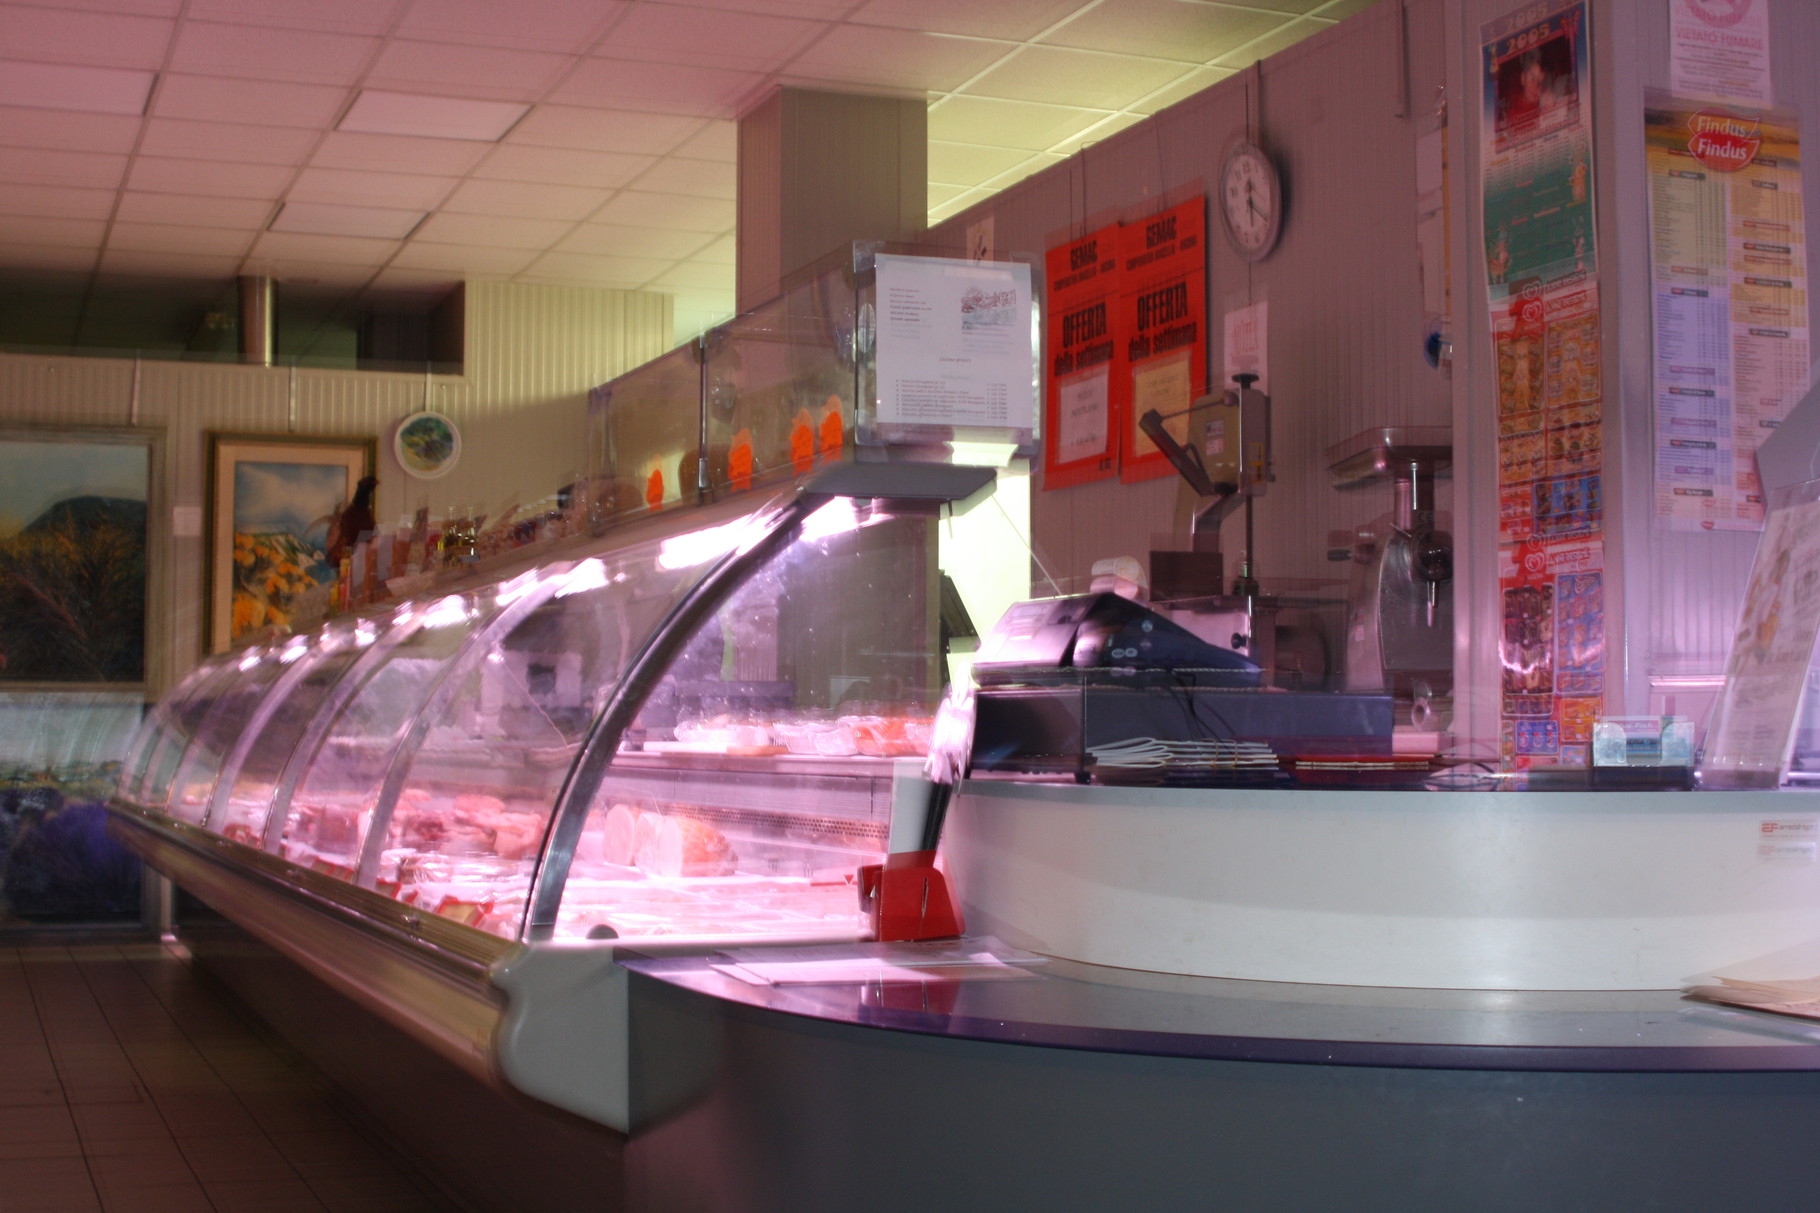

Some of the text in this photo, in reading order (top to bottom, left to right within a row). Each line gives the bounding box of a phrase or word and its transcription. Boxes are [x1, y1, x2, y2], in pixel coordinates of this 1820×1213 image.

[1506, 23, 1549, 54] 2005
[1675, 25, 1718, 44] VIETATO
[1697, 116, 1746, 137] Findus
[1698, 138, 1747, 160] Findus
[1137, 282, 1188, 331] OFFERTA
[1062, 302, 1107, 348] OFFERTA
[1128, 331, 1151, 362] della
[1153, 321, 1197, 355] settimana
[1054, 339, 1114, 377] della settimana
